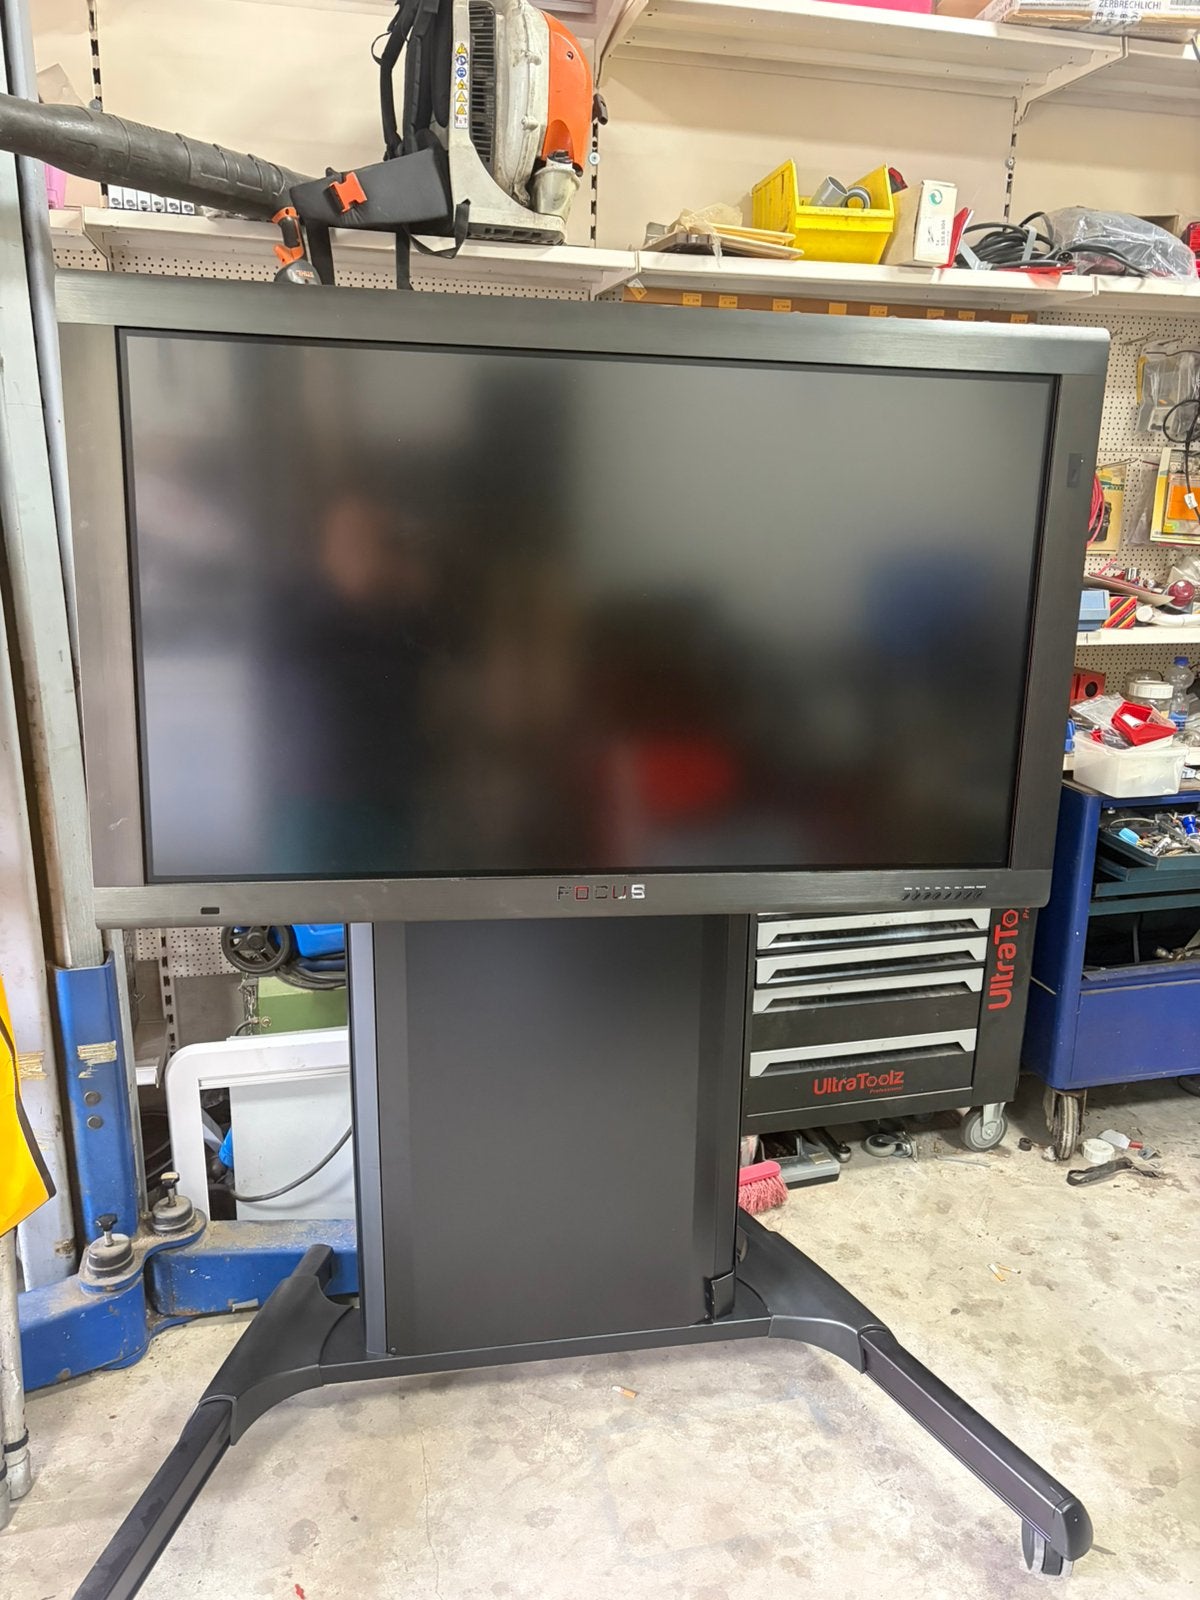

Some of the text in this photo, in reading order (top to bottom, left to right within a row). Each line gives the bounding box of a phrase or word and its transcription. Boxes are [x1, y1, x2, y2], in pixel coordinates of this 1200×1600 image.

[1098, 0, 1162, 10] ZERBRECHLICH!
[556, 883, 646, 901] FOCUS
[813, 1069, 905, 1095] UltraToolz
